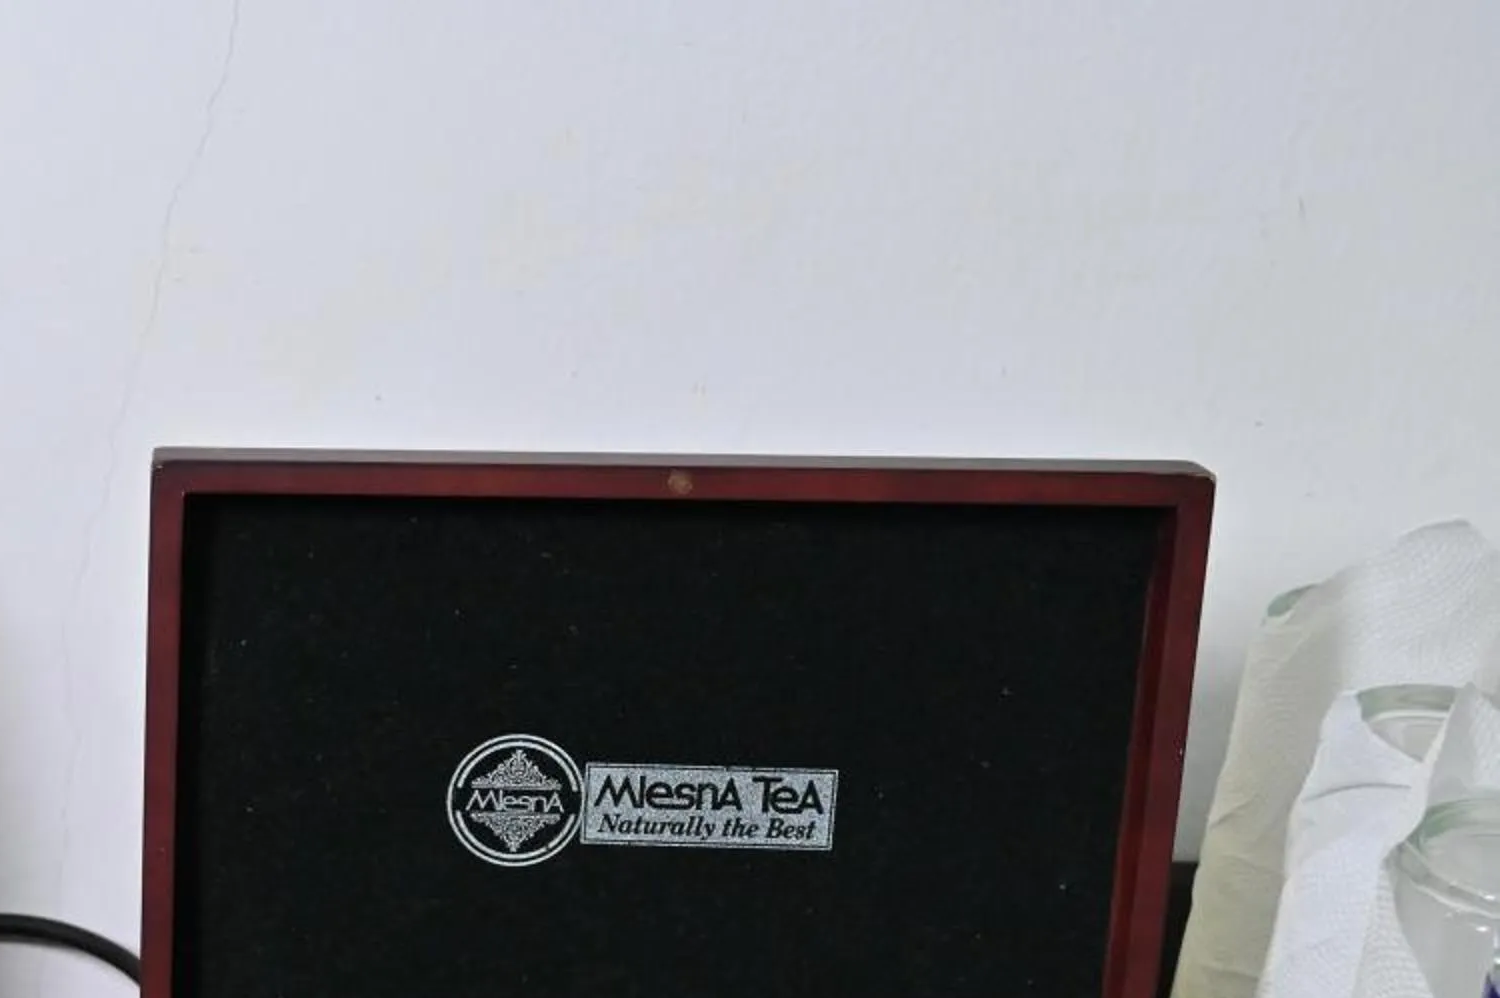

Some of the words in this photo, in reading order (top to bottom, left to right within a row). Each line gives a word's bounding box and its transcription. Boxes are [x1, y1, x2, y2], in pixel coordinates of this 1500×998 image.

[598, 812, 717, 841] Naturally
[722, 817, 759, 837] the
[766, 817, 817, 841] Best
